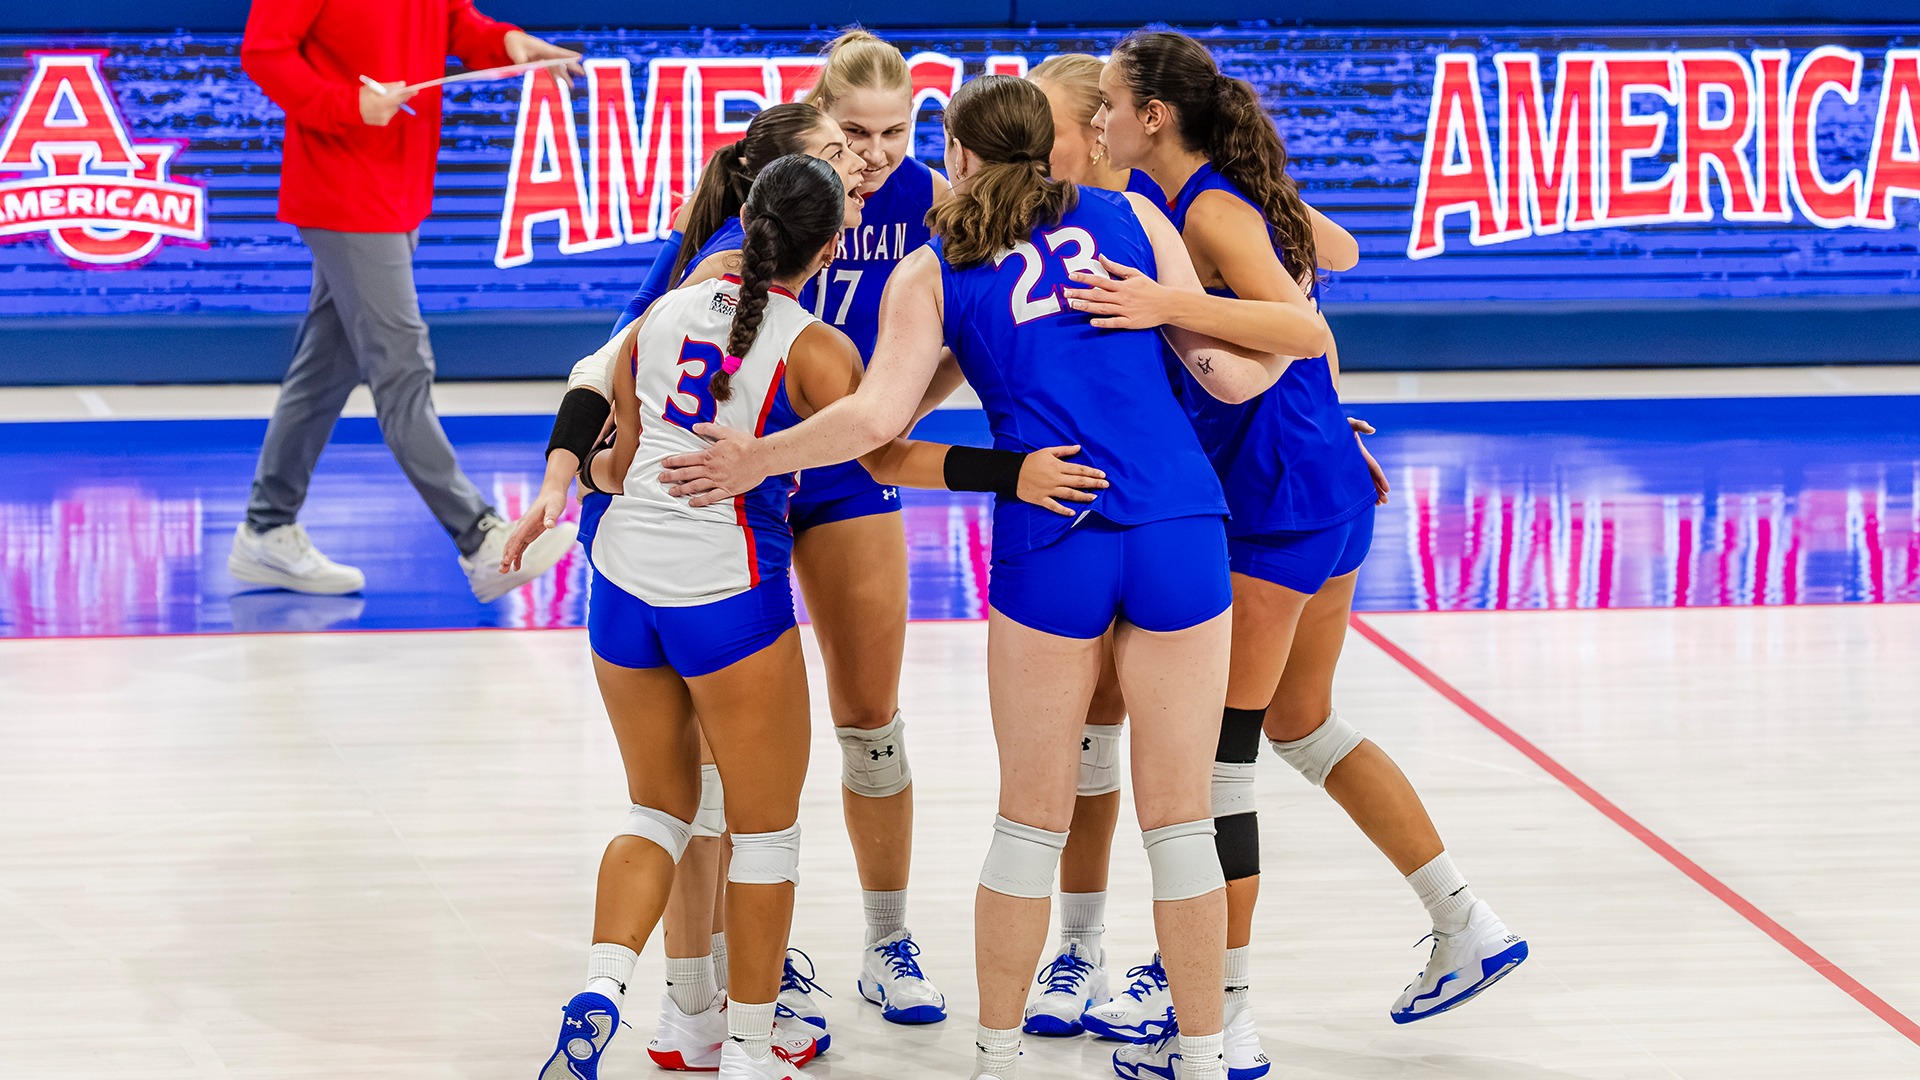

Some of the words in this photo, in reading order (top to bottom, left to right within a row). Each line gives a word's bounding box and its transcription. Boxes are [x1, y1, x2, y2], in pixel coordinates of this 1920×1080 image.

[0, 187, 192, 224] MERICAN
[836, 223, 907, 261] RICAN
[814, 267, 864, 325] 17
[993, 226, 1111, 327] 23
[662, 334, 726, 433] 3
